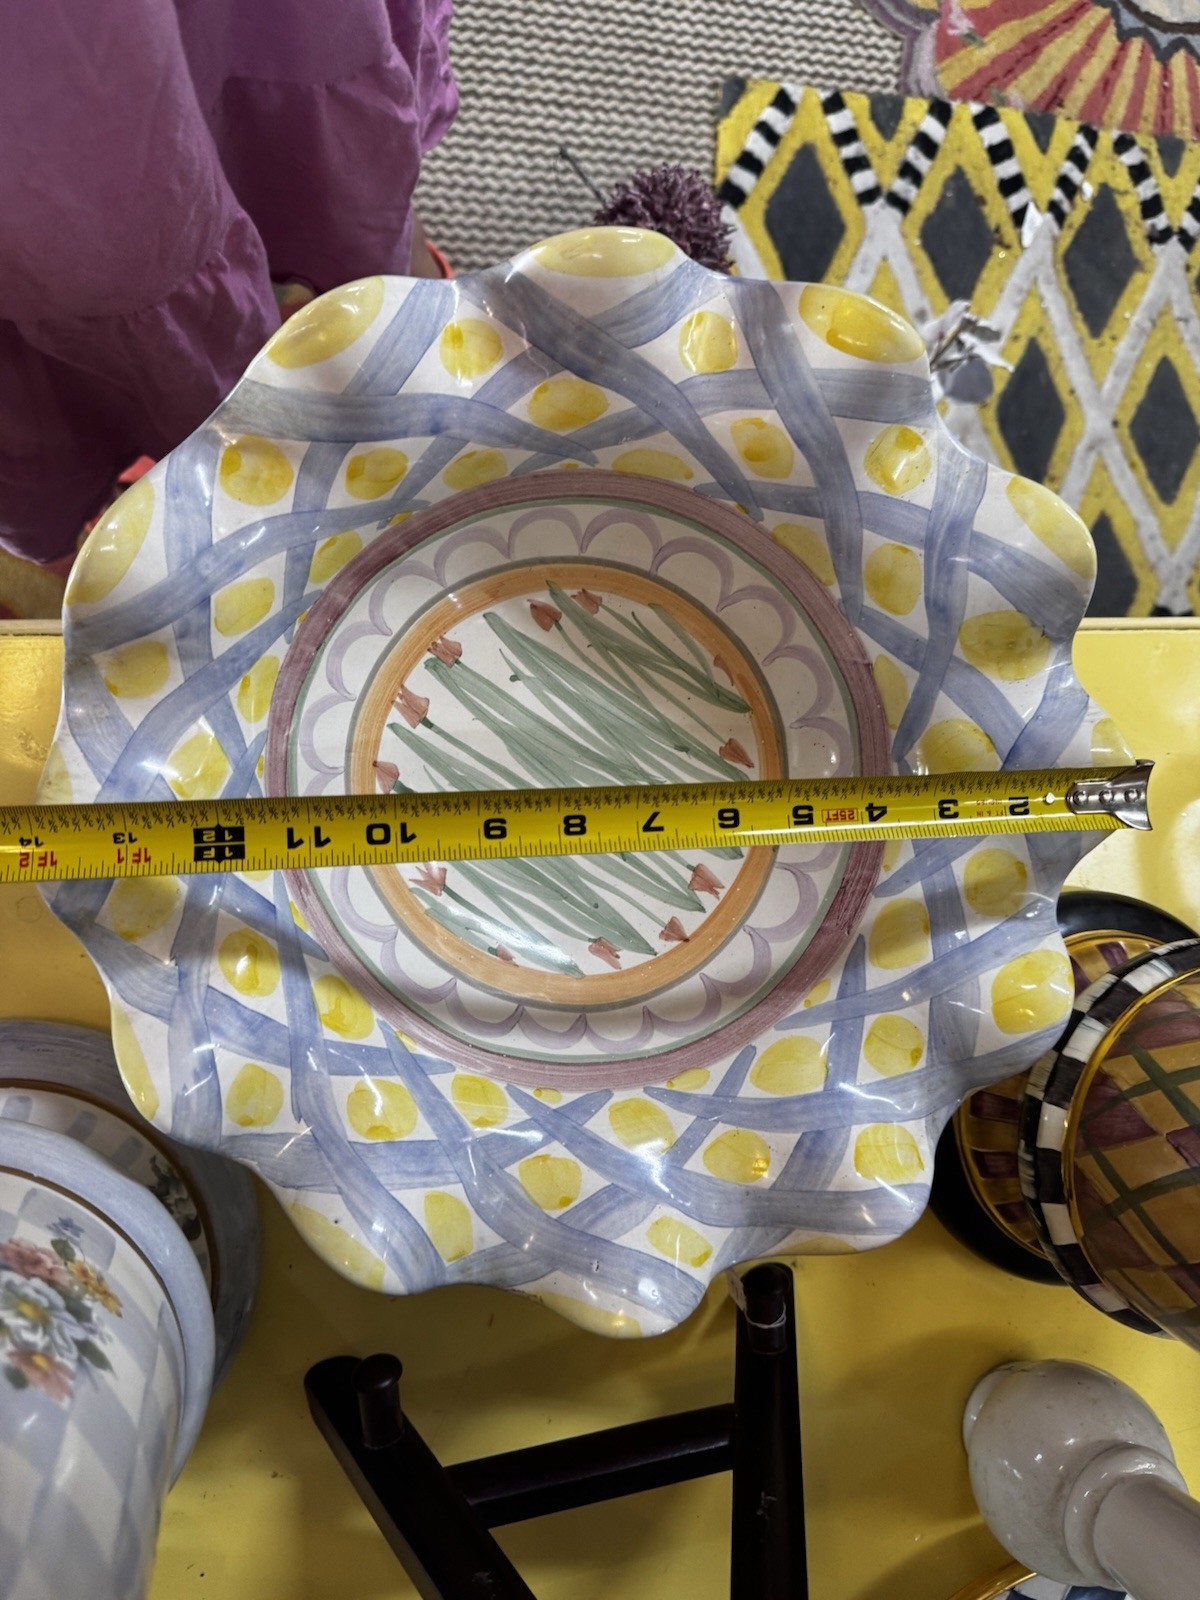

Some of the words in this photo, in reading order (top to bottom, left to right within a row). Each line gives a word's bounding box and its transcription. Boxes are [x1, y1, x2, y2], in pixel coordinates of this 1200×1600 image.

[792, 805, 814, 825] 5
[825, 809, 855, 821] 25FT
[865, 802, 888, 822] 4
[938, 798, 959, 819] 3
[1008, 796, 1030, 816] 2
[563, 814, 587, 836] 8
[642, 811, 665, 832] 7
[717, 808, 740, 829] 6
[112, 831, 138, 844] 13
[203, 830, 233, 842] 12
[286, 826, 331, 849] 11
[366, 822, 417, 845] 10
[483, 818, 507, 840] 9
[19, 836, 44, 848] 14
[19, 852, 30, 868] 2
[38, 850, 57, 867] 1F
[117, 848, 124, 864] 1
[132, 848, 151, 864] 1F
